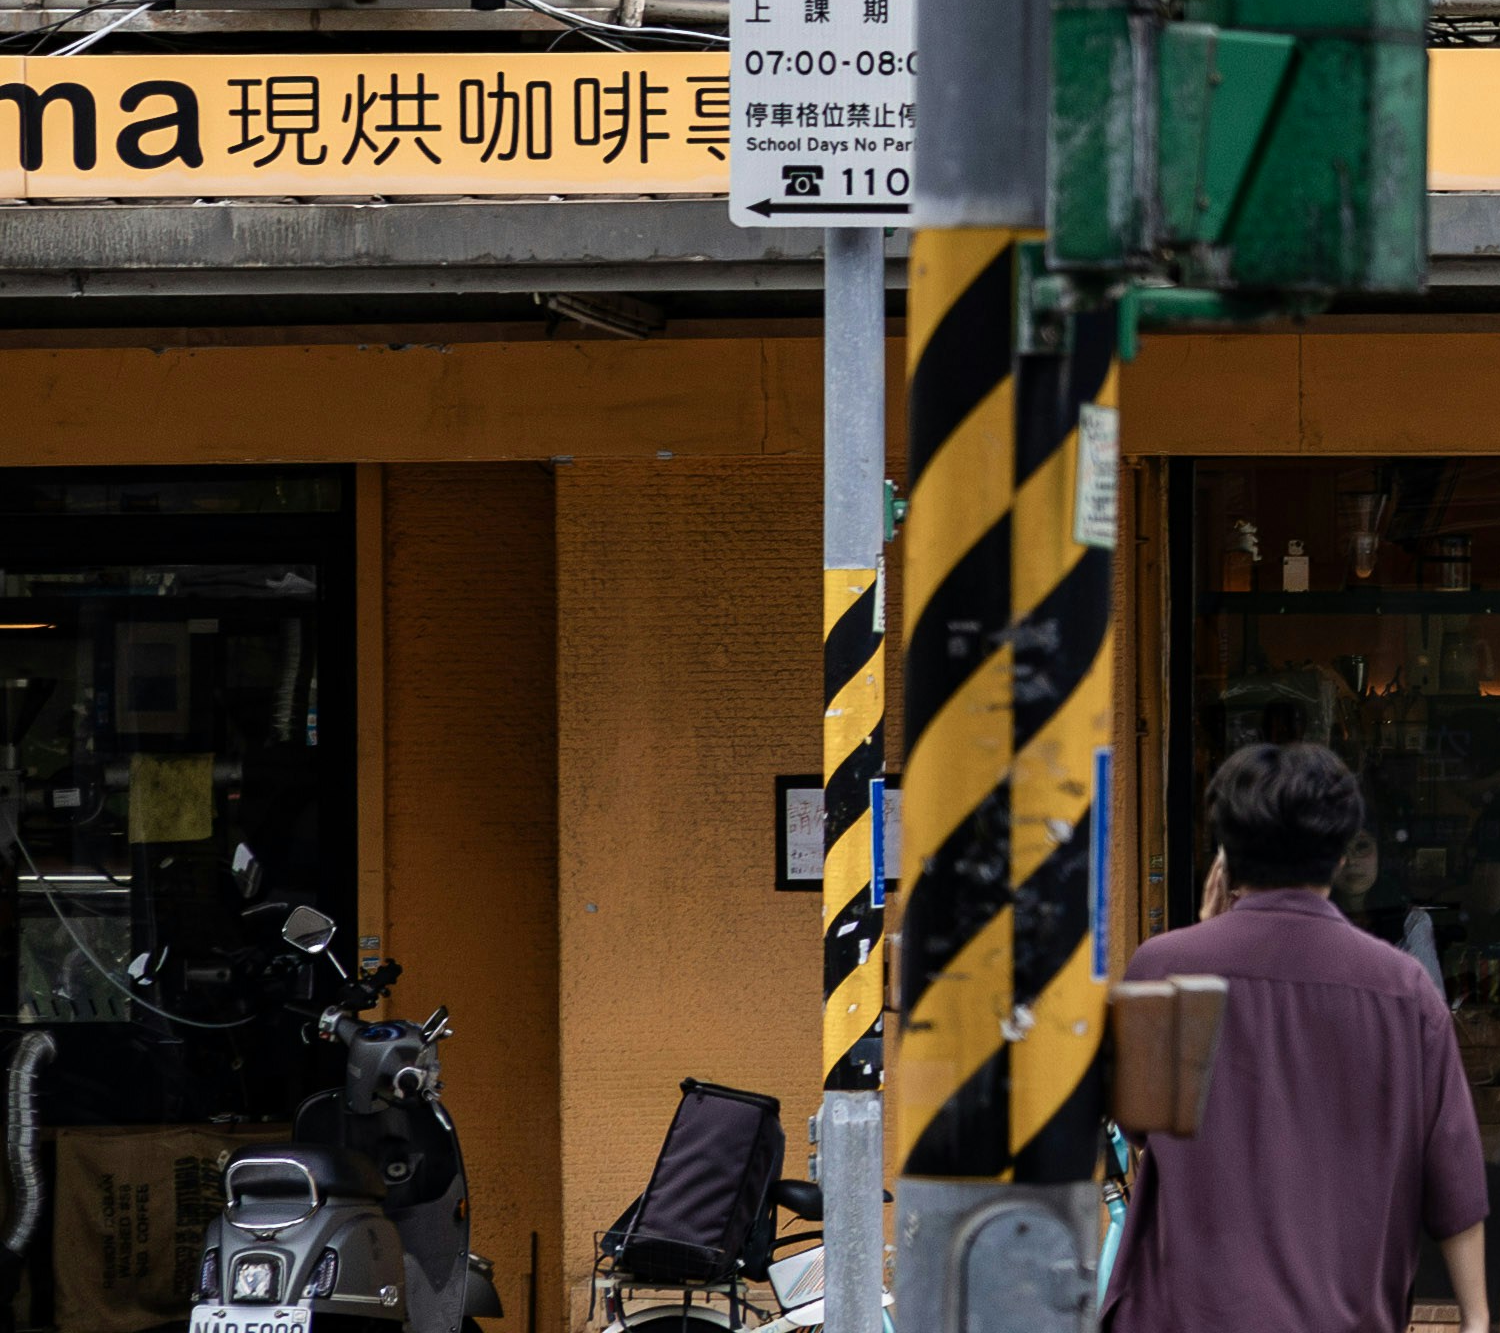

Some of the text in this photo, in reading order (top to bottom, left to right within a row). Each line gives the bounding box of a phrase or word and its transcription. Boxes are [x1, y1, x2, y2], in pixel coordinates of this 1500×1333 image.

[746, 137, 915, 155] School Days No Par
[842, 167, 910, 196] 110
